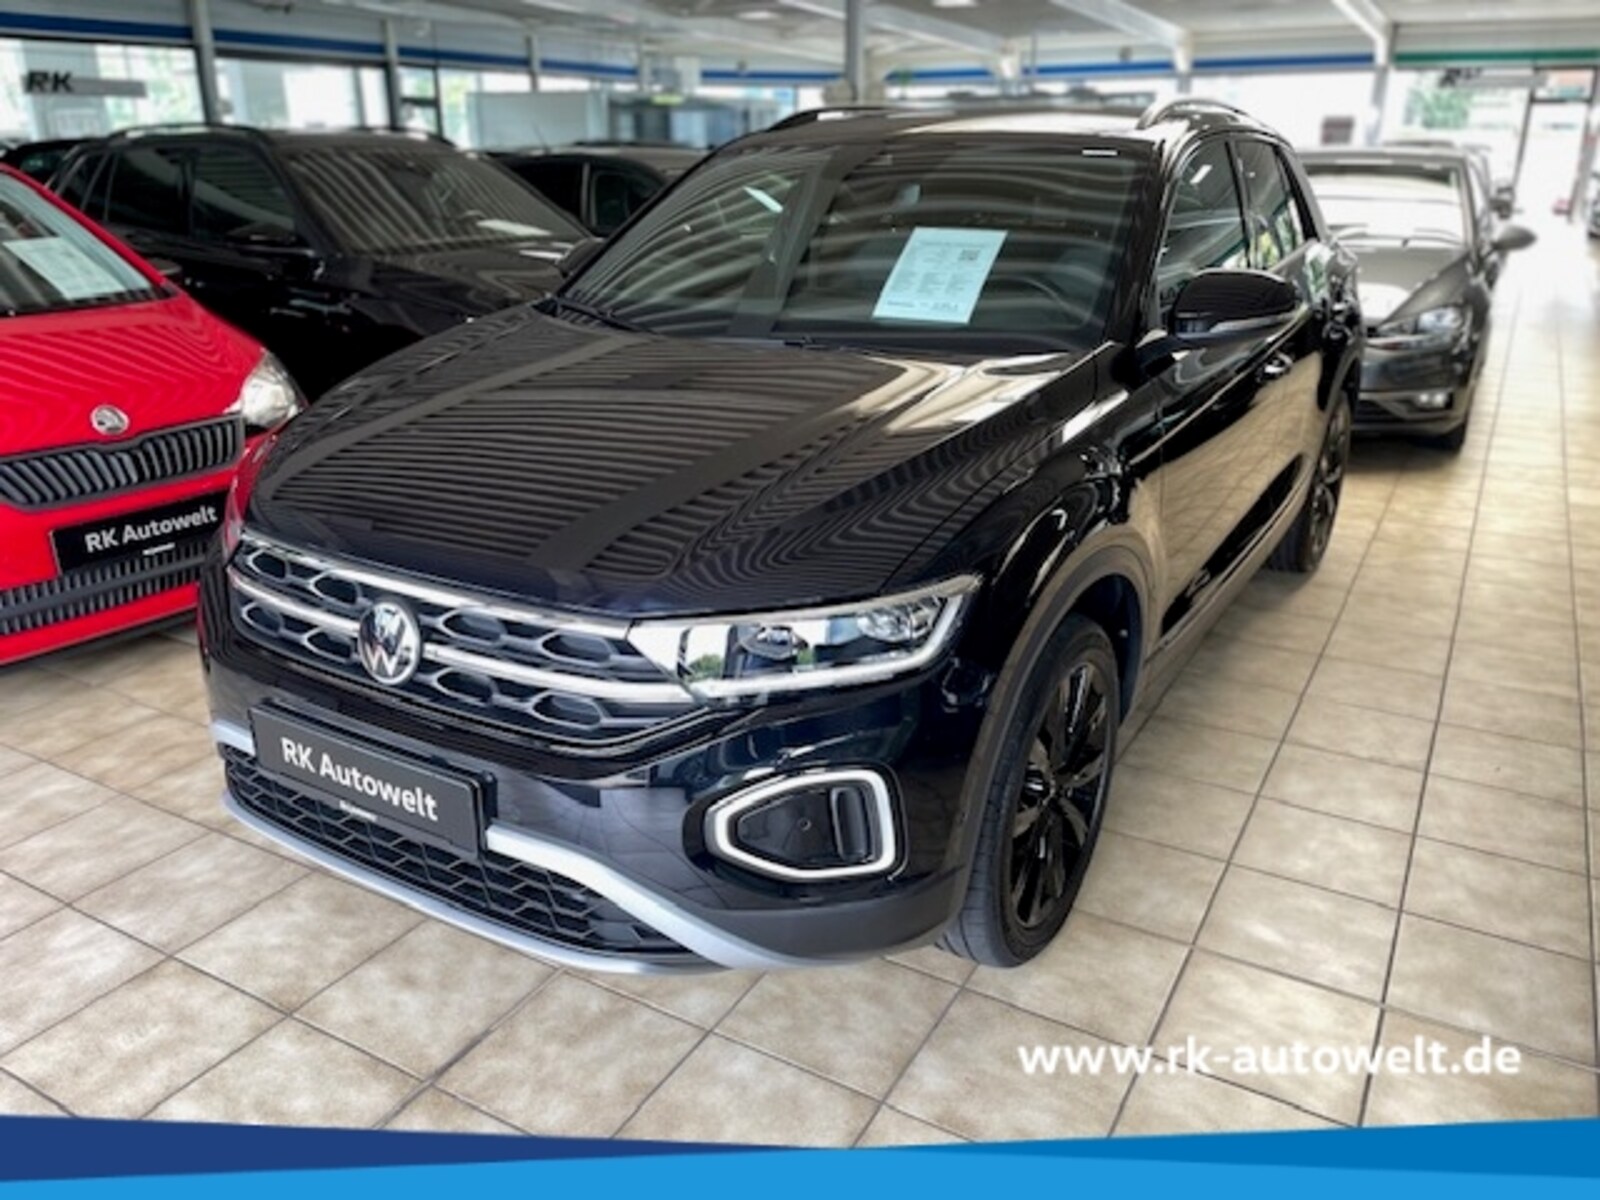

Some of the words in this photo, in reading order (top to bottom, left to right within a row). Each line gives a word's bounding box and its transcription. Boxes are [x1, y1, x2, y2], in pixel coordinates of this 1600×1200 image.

[25, 70, 73, 94] RK
[84, 527, 119, 554] RK
[122, 505, 218, 545] Autowelt
[281, 736, 316, 774] RK
[319, 753, 439, 822] Autowelt
